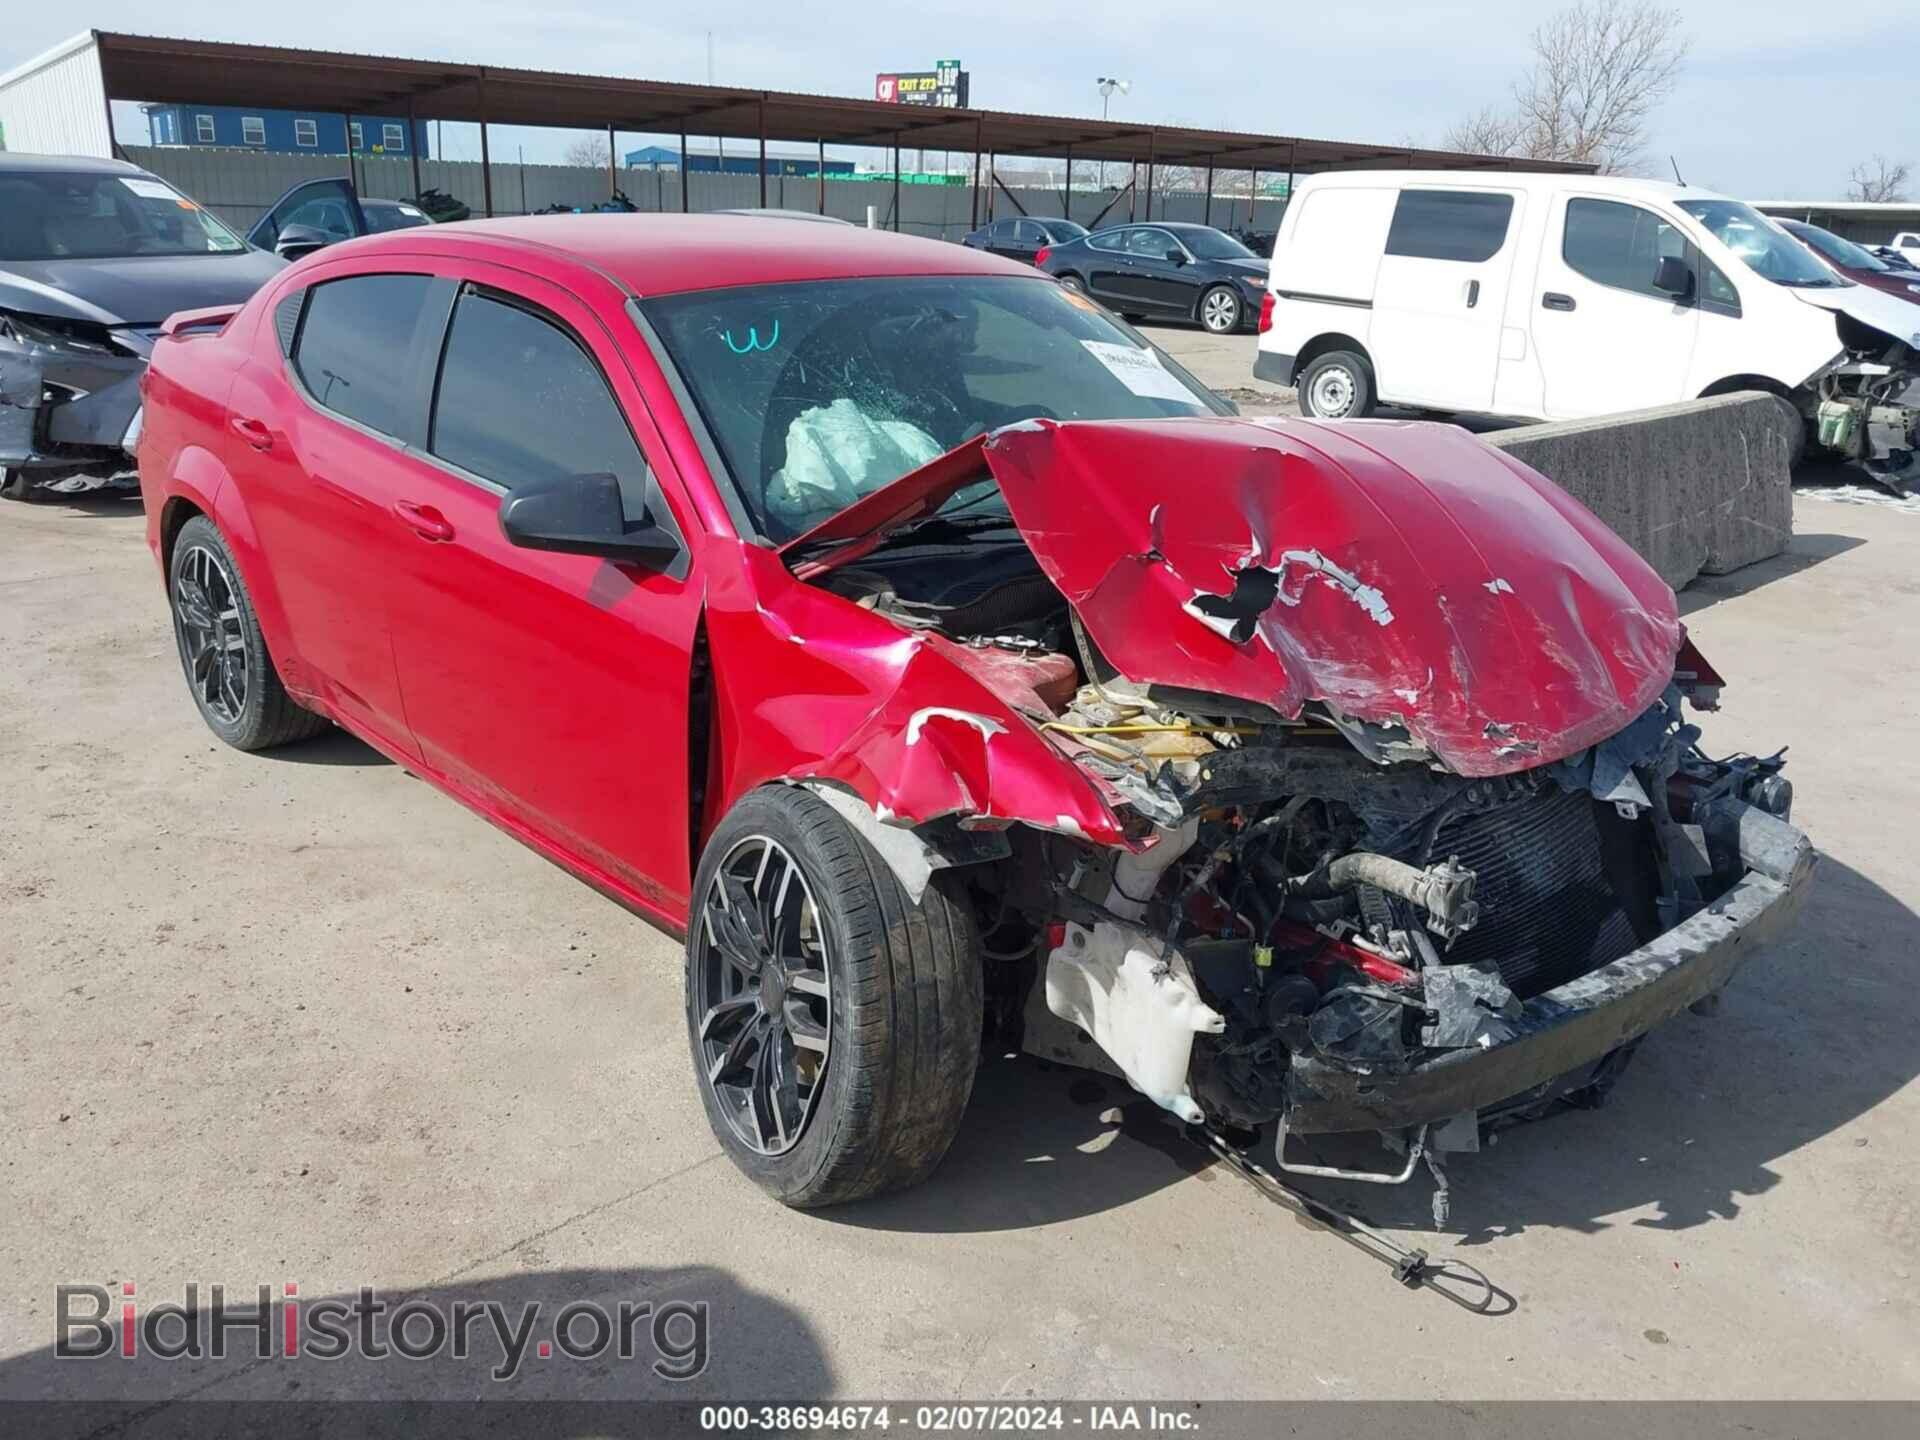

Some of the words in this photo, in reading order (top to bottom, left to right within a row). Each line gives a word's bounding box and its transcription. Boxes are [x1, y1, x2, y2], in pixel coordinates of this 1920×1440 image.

[879, 80, 895, 99] QT
[898, 79, 918, 91] EXIT
[919, 78, 936, 91] 273
